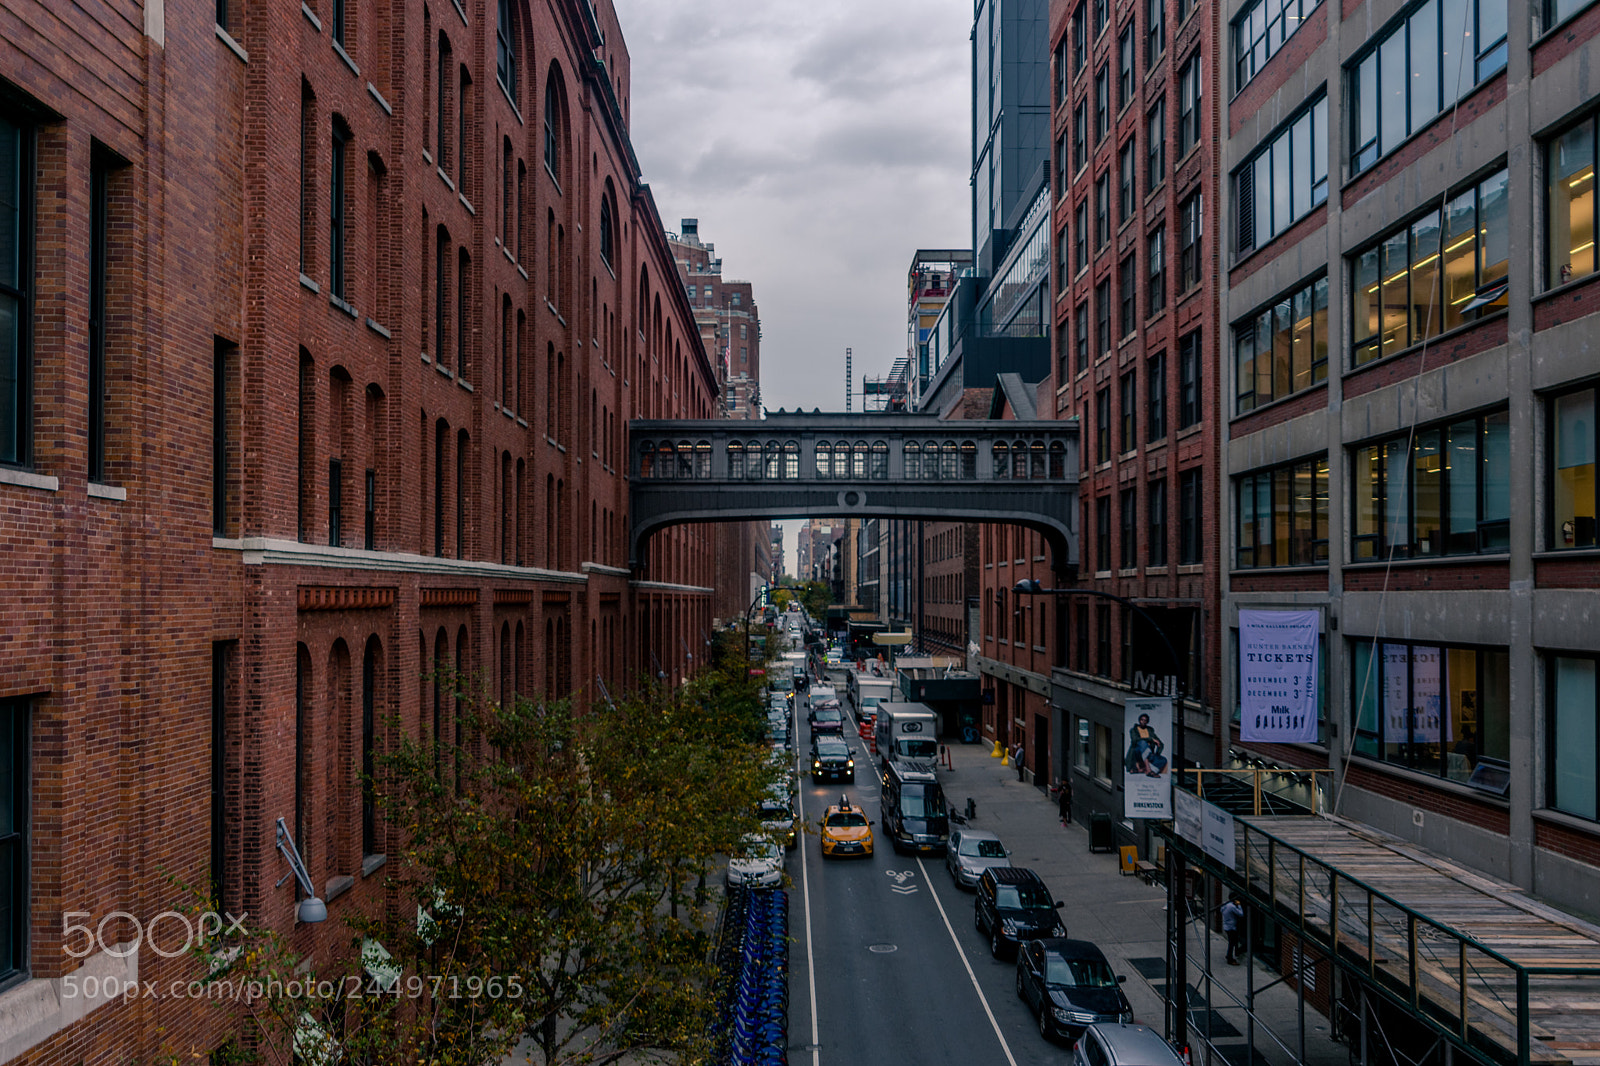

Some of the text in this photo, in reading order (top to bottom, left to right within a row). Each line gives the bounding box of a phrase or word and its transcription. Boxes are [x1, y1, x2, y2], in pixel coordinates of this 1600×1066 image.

[1246, 653, 1314, 663] TICKETS
[1305, 675, 1314, 698] 2017
[1271, 705, 1290, 714] Milk
[1255, 714, 1305, 729] GALLERY
